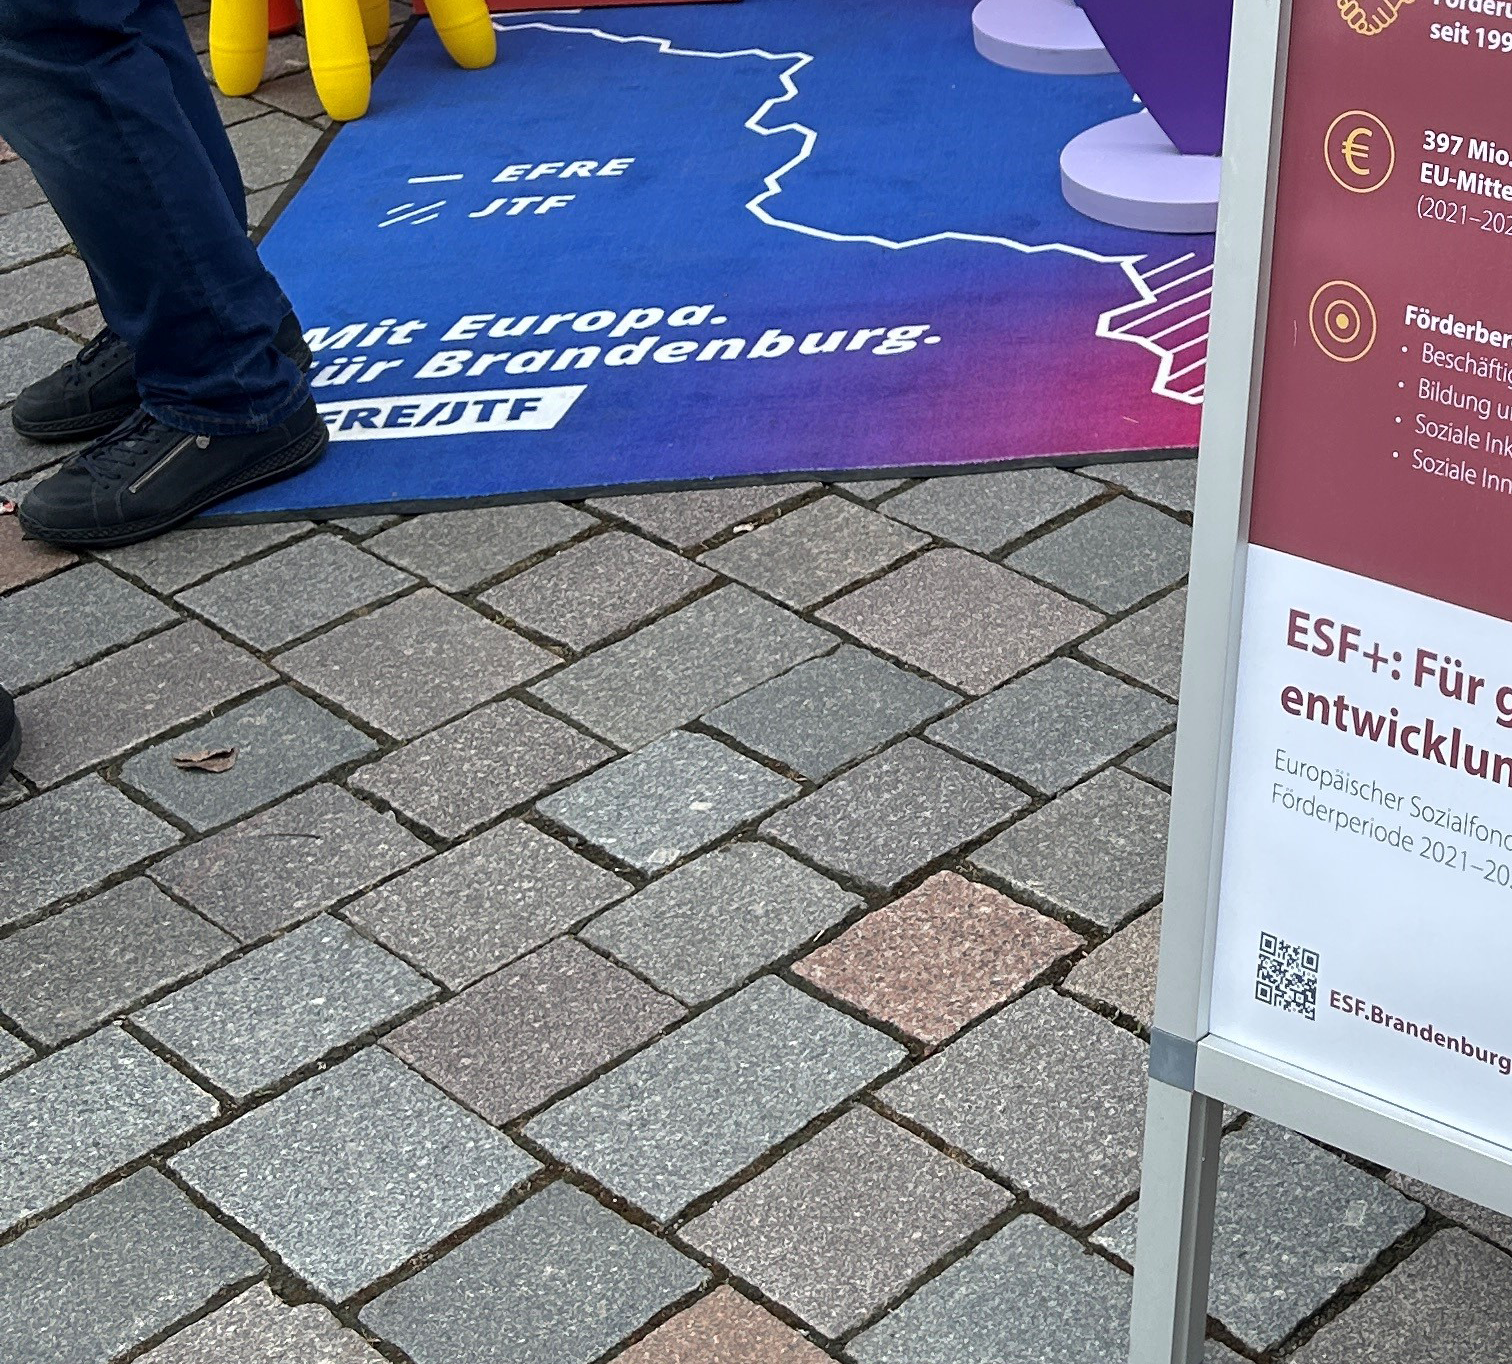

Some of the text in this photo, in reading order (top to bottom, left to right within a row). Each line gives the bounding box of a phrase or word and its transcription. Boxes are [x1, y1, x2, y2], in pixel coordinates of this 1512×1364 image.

[1430, 22, 1469, 45] seit
[1423, 131, 1463, 155] 397
[491, 158, 635, 182] EFRE
[469, 195, 575, 217] JTF
[302, 305, 727, 352] Mit Europa.
[310, 325, 940, 387] ür Brandenburg.
[1419, 378, 1491, 420] Bildung
[1415, 414, 1480, 449] Soziale
[1412, 449, 1476, 484] Soziale
[1287, 608, 1401, 680] ESF+:
[1414, 648, 1485, 705] Für
[1274, 749, 1404, 811] Europäischer
[1273, 783, 1413, 852] Förderperiode
